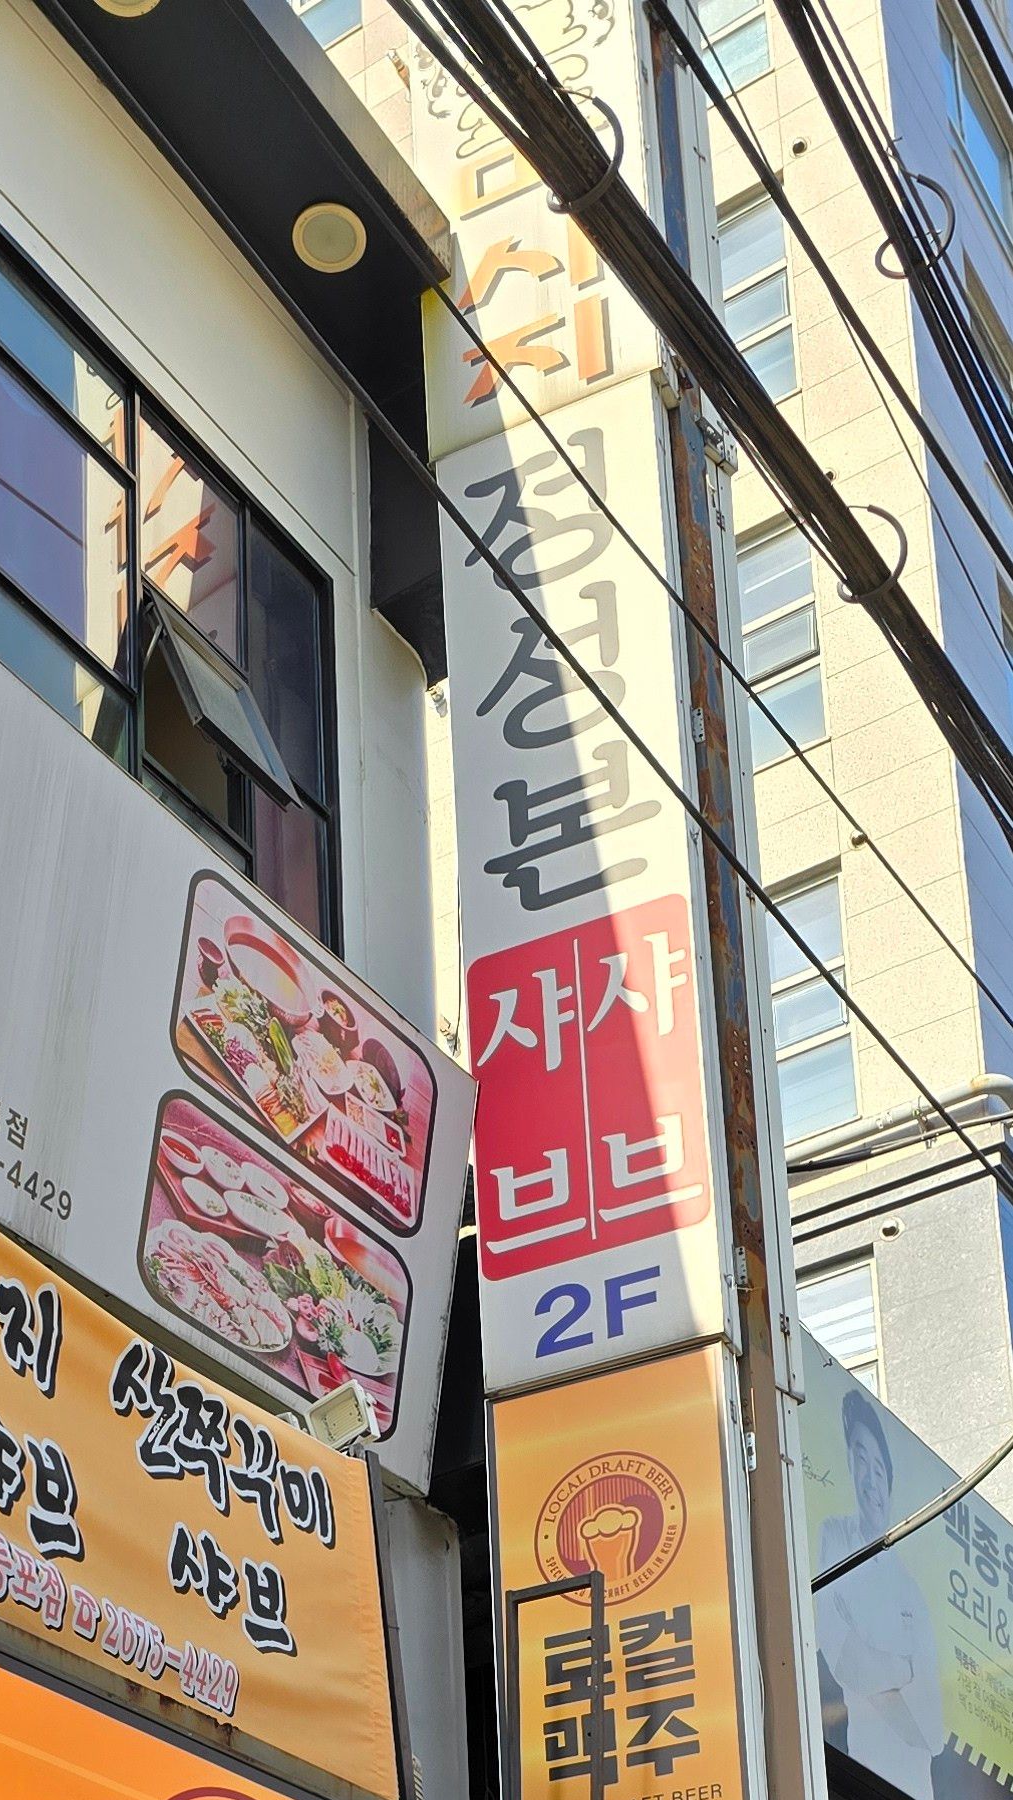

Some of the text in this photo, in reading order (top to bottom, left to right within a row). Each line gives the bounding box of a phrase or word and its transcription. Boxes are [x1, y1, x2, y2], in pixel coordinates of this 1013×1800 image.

[464, 426, 661, 912] 정성본
[533, 1265, 661, 1359] 2F
[544, 1460, 675, 1523] LOCAL DRAFT BEER
[168, 1521, 297, 1657] 샤브
[634, 1568, 655, 1588] BEER
[663, 1524, 678, 1555] KOREA
[102, 1597, 239, 1716] 2675-4429
[544, 1604, 696, 1708] 로컬
[543, 1693, 700, 1786] 맥주
